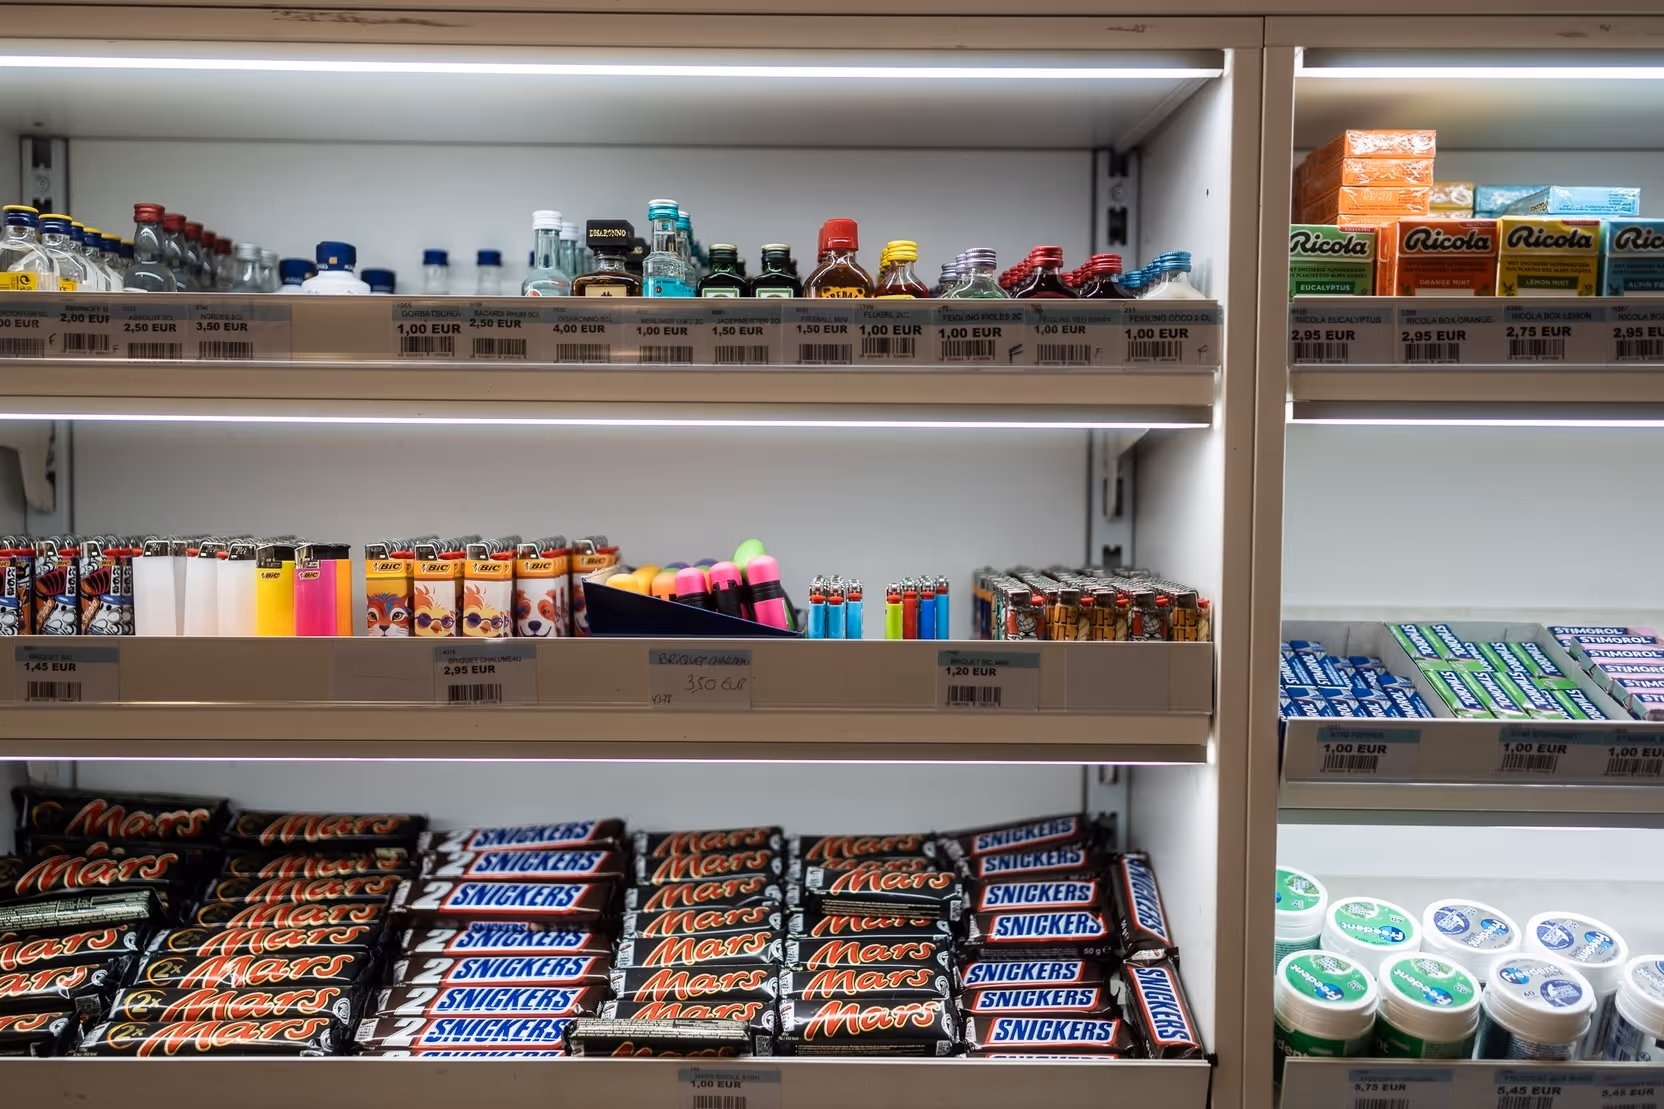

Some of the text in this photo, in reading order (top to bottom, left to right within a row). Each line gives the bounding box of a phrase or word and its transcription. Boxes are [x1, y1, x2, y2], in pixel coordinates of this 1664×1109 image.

[589, 229, 627, 238] DISARONNO
[1290, 230, 1369, 255] Ricola
[1404, 227, 1491, 251] Ricola
[1507, 225, 1593, 249] Ricola
[1300, 284, 1351, 292] EUCALYPTUS
[15, 319, 40, 329] EUR
[60, 313, 85, 324] 2,00
[469, 319, 521, 329] 2,50 EUR
[557, 315, 599, 323] DISARONNO
[1168, 314, 1193, 322] COCO
[1406, 317, 1437, 325] RICOLA
[1457, 316, 1493, 324] ORANGE
[1511, 312, 1542, 320] RICOLA
[123, 323, 177, 333] 2,50 EUR
[196, 322, 248, 332] 3,50 EUR
[397, 324, 461, 336] 1,00 EUR
[552, 324, 605, 334] 4,00 EUR
[636, 327, 688, 337] 1,00 EUR
[712, 326, 763, 336] 1,50 EUR
[796, 325, 848, 335] 1,50 EUR
[859, 325, 922, 337] 1,00 EUR
[938, 328, 1002, 340] 1,00 EUR
[1034, 325, 1086, 335] 1,00 EUR
[1124, 328, 1189, 340] 1,00 EUR
[1291, 330, 1356, 342] 2,95 EUR
[1402, 330, 1467, 343] 2,95 EUR
[1506, 327, 1571, 338] 2,75 EUR
[1613, 328, 1643, 338] 2,95
[428, 564, 449, 572] BIC
[479, 564, 502, 572] BIC
[586, 557, 606, 565] BIC
[304, 571, 319, 579] BIC
[1401, 624, 1434, 656] STIMOROL
[1432, 624, 1466, 656] STIMOROL
[1554, 627, 1624, 635] STIMOROL
[1579, 636, 1651, 644] STIMOROL
[1491, 642, 1527, 672] STIMOROL
[1522, 642, 1558, 674] STIMOROL
[1589, 649, 1661, 658] STIMOROL
[24, 662, 77, 673] 1,45 EUR
[444, 665, 496, 676] 2,95 EUR
[945, 667, 997, 677] 1,20 EUR
[1442, 671, 1477, 707] STIMOROL
[1474, 671, 1513, 708] STIMOROL
[1508, 670, 1548, 707] STIMOROL
[1324, 743, 1387, 754] 1,00 EUR
[1504, 742, 1567, 753] 1,00 EUR
[1608, 747, 1638, 757] 1,00
[64, 799, 211, 838] Mars
[259, 813, 410, 845] Mars
[437, 821, 596, 852] 2 SNICKERS
[652, 828, 770, 858] Mars
[977, 817, 1073, 850] SNICKERS
[806, 835, 924, 860] Mars
[435, 850, 602, 877] 2 SNICKERS
[651, 850, 772, 886] Mars
[984, 849, 1081, 872] SNICKERS
[15, 853, 179, 896] Mars
[829, 868, 956, 896] Mars
[244, 875, 401, 905] Mars
[410, 881, 583, 910] 2 SNICKERS
[643, 877, 767, 913] Mars
[986, 884, 1091, 905] SNICKERS
[1128, 858, 1166, 938] SNICKERS
[226, 902, 386, 929] Mars
[642, 906, 771, 939] Mars
[996, 914, 1102, 936] SNICKERS
[197, 925, 371, 957] Mars
[415, 928, 585, 952] 2 SNICKERS
[1341, 921, 1405, 942] freedent
[642, 931, 772, 967] Mars
[807, 940, 936, 971] Mars
[179, 954, 355, 989] Mars
[411, 957, 590, 984] 2 SNICKERS
[967, 963, 1078, 982] SNICKERS
[1501, 965, 1559, 983] freedent
[634, 968, 768, 1002] Mars
[801, 968, 935, 1001] Mars
[1289, 963, 1343, 1000] freedent
[1393, 968, 1452, 1005] freedent
[159, 987, 341, 1022] Mars
[394, 987, 580, 1016] 2 SNICKERS
[980, 990, 1094, 1008] SNICKERS
[1137, 968, 1190, 1042] SNICKERS
[803, 1000, 940, 1041] Mars
[994, 1019, 1113, 1041] SNICKERS
[137, 1017, 331, 1057] Mars
[381, 1017, 428, 1047] 2
[423, 1018, 570, 1043] SNICKERS
[690, 1080, 741, 1089] 1,00 EUR
[1354, 1083, 1379, 1092] 5,75
[1497, 1086, 1561, 1096] 5,45 EUR
[1630, 1088, 1655, 1096] EUR
